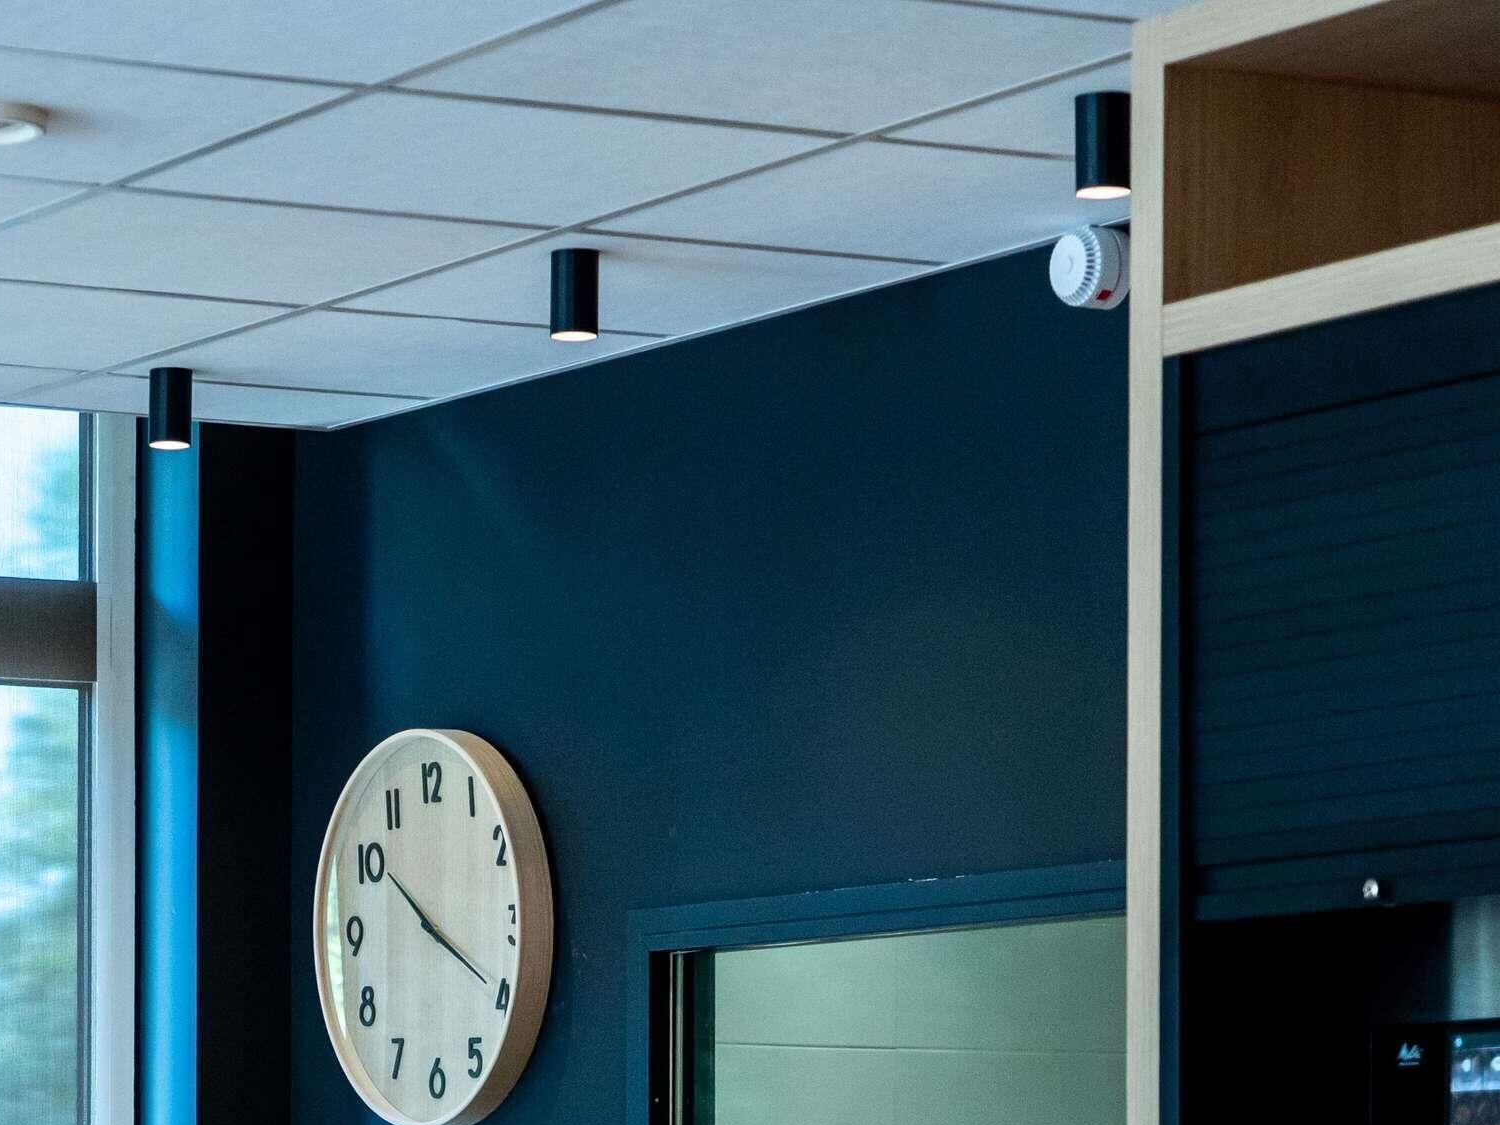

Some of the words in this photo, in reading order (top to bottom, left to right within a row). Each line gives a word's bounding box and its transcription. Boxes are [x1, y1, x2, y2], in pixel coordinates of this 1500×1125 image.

[421, 761, 442, 804] 12
[468, 776, 476, 817] 1
[385, 788, 401, 831] 11
[358, 841, 385, 885] 10
[493, 824, 507, 867] 2
[346, 915, 364, 957] 9
[359, 985, 376, 1027] 8
[494, 977, 510, 1019] 4
[391, 1037, 405, 1080] 7
[428, 1057, 446, 1100] 6
[467, 1036, 483, 1080] 5
